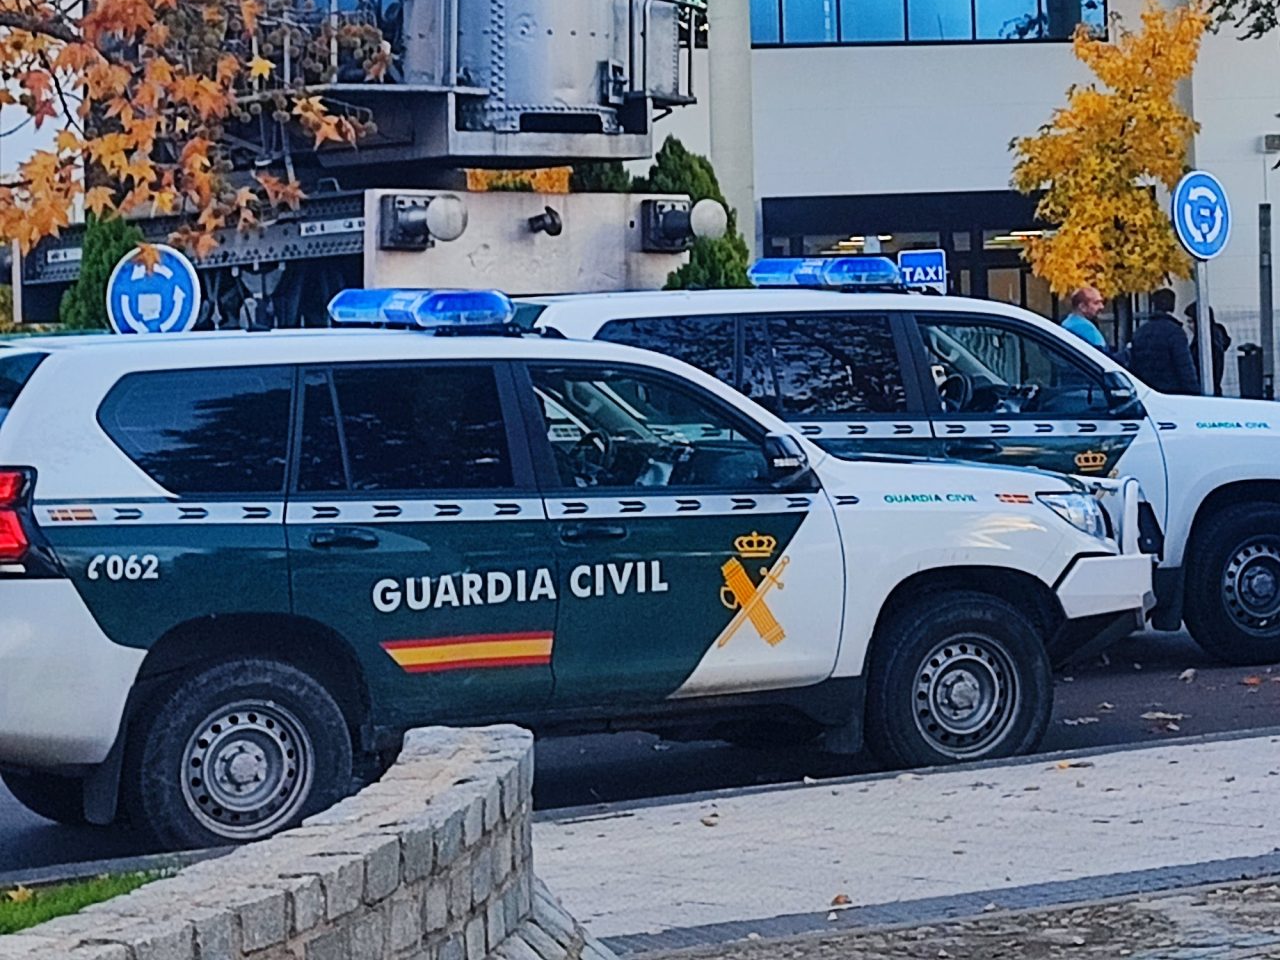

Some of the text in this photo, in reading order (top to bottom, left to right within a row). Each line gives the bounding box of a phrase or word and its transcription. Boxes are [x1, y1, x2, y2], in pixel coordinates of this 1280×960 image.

[902, 265, 943, 282] TAXI
[883, 493, 978, 503] GUARDIA CIVIL
[106, 554, 159, 580] 062
[372, 560, 669, 613] GUARDIA CIVIL
